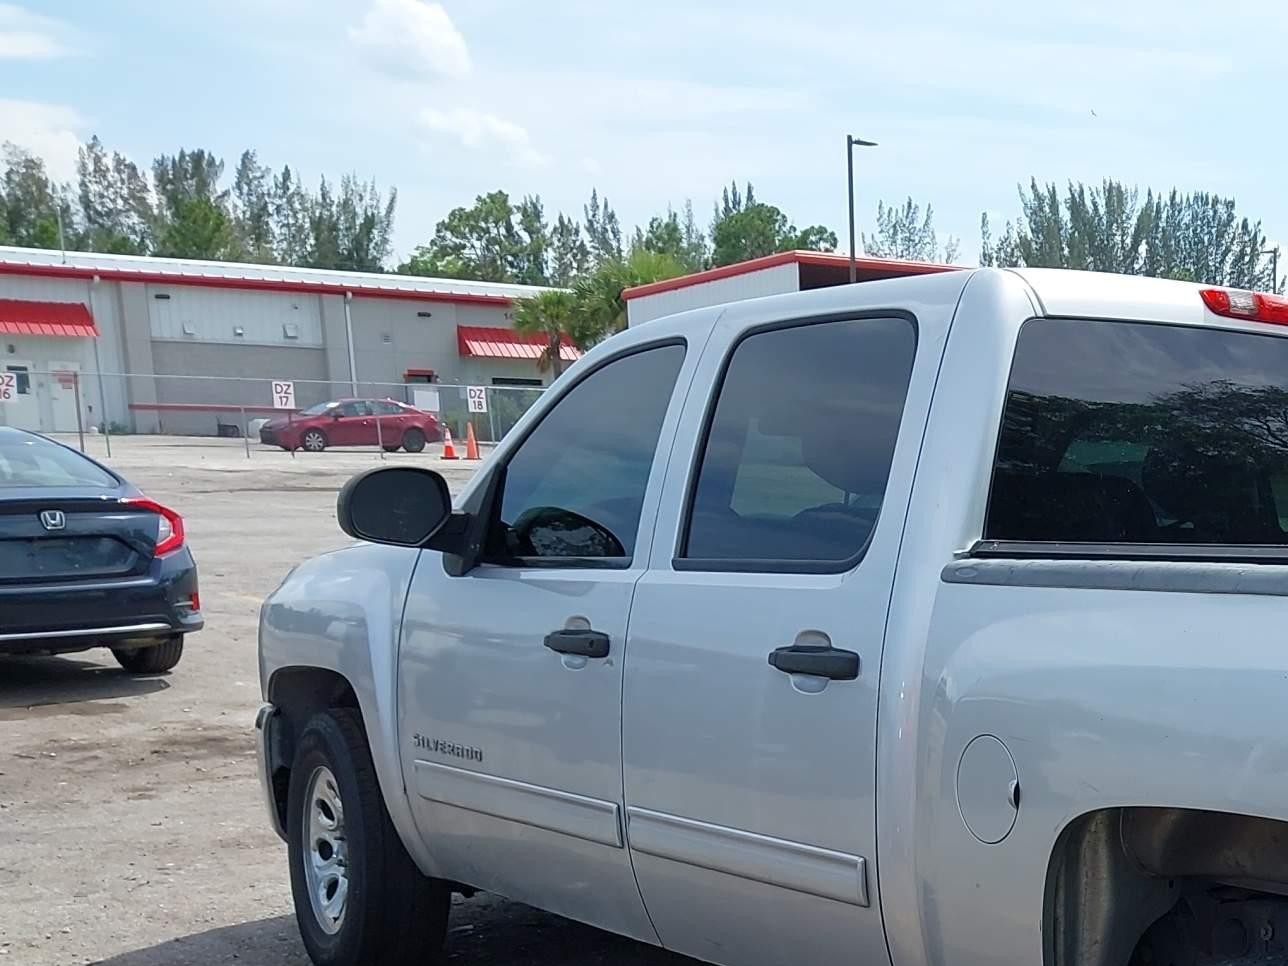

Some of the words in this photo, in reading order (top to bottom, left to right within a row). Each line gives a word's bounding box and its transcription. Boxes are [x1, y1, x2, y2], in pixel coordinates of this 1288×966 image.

[274, 383, 292, 395] DZ
[468, 389, 484, 400] DZ
[278, 395, 289, 407] 17
[472, 400, 484, 410] 18
[413, 733, 483, 762] SILVERADO
